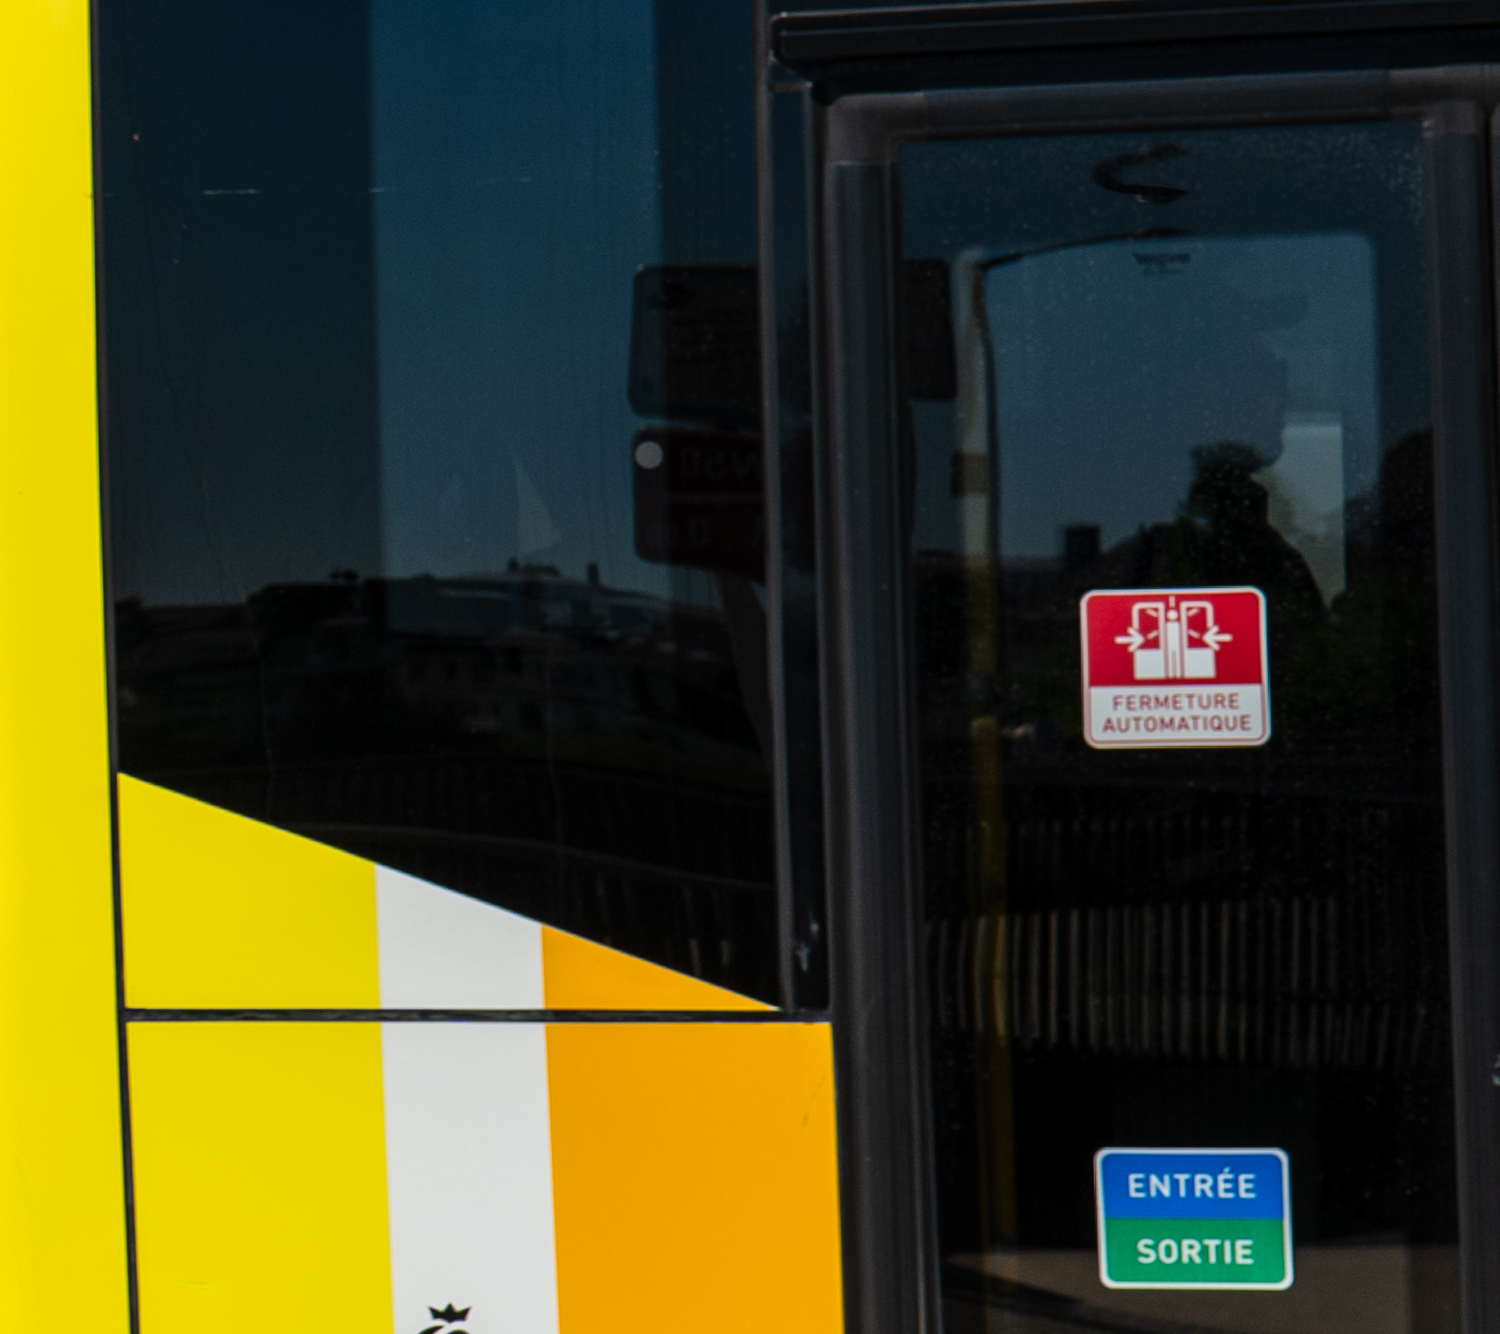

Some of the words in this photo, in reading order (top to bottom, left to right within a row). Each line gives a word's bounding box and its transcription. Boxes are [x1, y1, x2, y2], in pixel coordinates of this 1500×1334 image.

[1112, 693, 1240, 711] FERMETURE
[1102, 713, 1252, 733] AUTOMATIQUE
[1128, 1166, 1257, 1199] ENTRÉE
[1137, 1238, 1255, 1265] SORTIE
